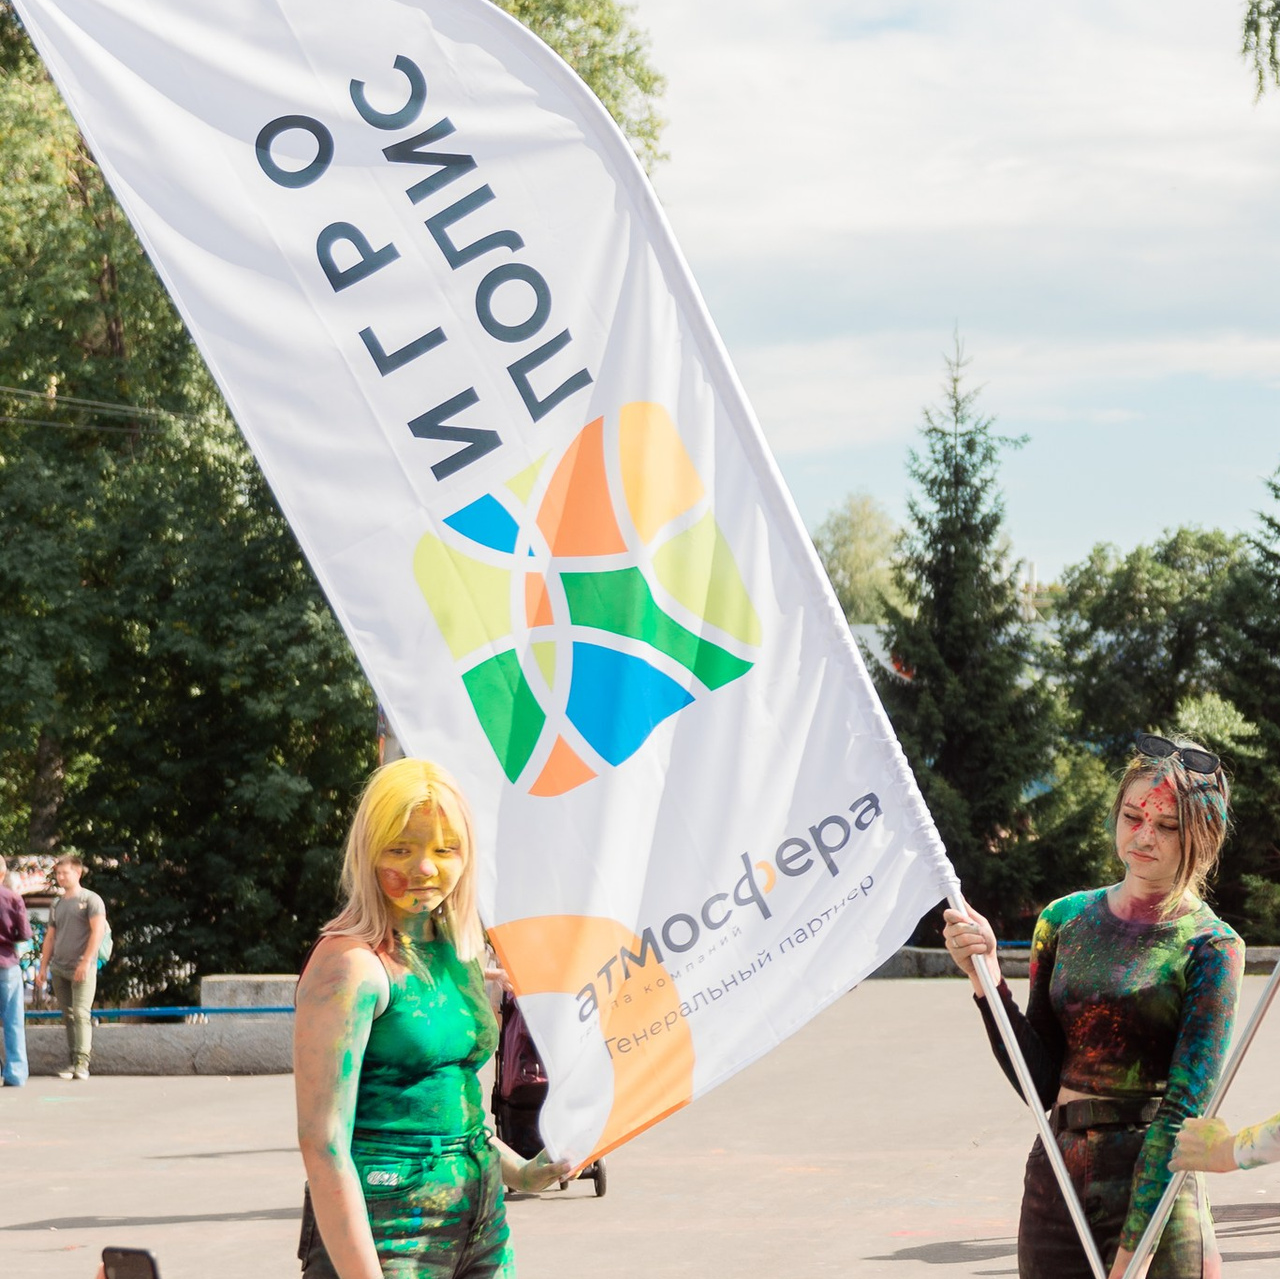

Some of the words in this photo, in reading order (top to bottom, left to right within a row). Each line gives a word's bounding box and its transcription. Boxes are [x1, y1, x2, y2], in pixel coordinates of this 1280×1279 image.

[254, 112, 504, 482] ИГРО
[348, 53, 593, 423] ПОЛИС
[574, 791, 884, 1023] атмосфера
[604, 949, 774, 1060] Генеральный
[779, 874, 875, 955] партнер
[644, 926, 743, 994] компаний
